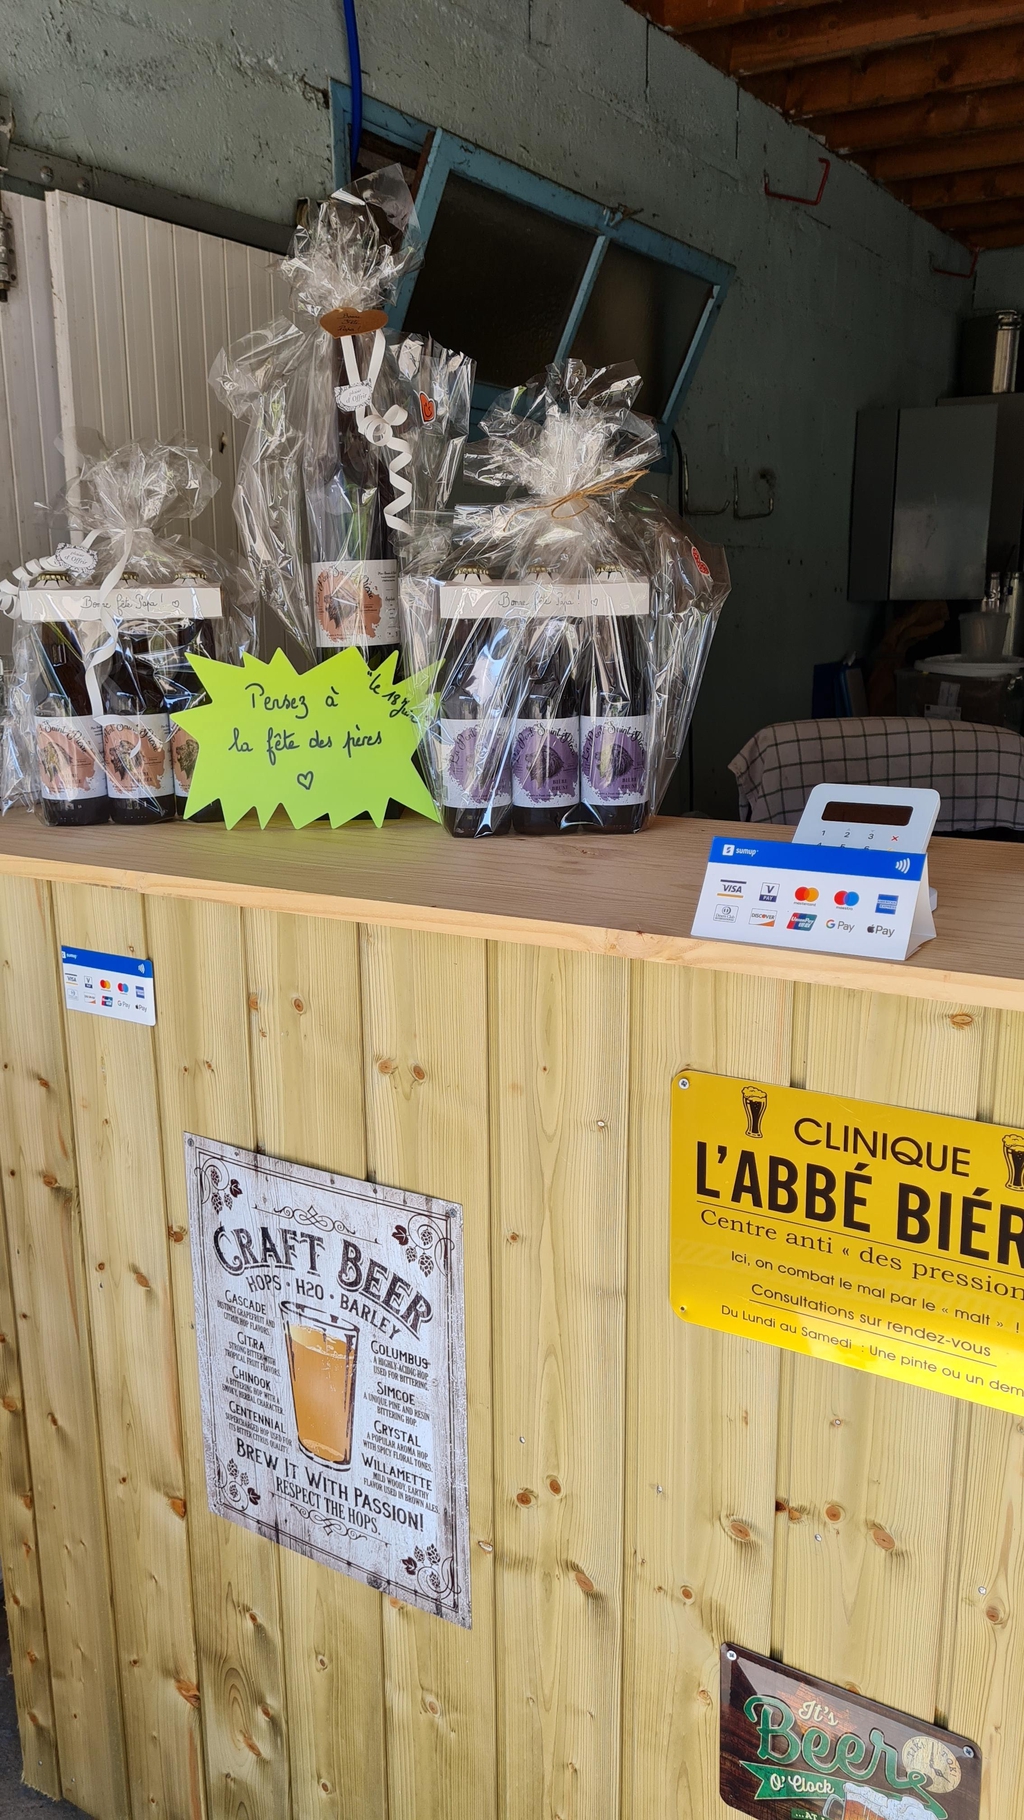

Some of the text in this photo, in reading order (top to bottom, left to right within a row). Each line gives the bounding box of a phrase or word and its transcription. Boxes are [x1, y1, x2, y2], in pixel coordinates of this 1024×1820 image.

[325, 686, 340, 707] à
[381, 691, 401, 705] 18
[228, 724, 382, 766] la fête des pères
[722, 884, 742, 893] VISA
[837, 920, 855, 933] Pay
[875, 925, 895, 938] Pay
[793, 1117, 971, 1178] CLINIQUE
[696, 1140, 873, 1233] L'ABBÉ
[700, 1208, 778, 1240] Centre
[785, 1231, 833, 1255] anti
[859, 1247, 903, 1272] des
[213, 1225, 434, 1337] CRAFT BEER
[731, 1250, 751, 1267] Ici,
[755, 1258, 773, 1271] on
[777, 1264, 835, 1286] combat
[839, 1277, 853, 1290] le
[857, 1283, 885, 1299] mal
[890, 1292, 917, 1307] par
[922, 1298, 936, 1312] le
[954, 1308, 991, 1326] malt
[225, 1289, 267, 1316] CASCADE
[246, 1274, 282, 1293] HOPS
[340, 1293, 400, 1341] BARLEY
[224, 1311, 240, 1325] CITRUS
[751, 1283, 991, 1357] Consultations sur rendez-vous
[228, 1341, 247, 1355] STRONG
[237, 1331, 265, 1353] CITRA
[370, 1340, 429, 1369] COLUMBUS
[721, 1304, 738, 1318] Du
[742, 1310, 776, 1328] Lundi
[779, 1321, 797, 1334] au
[801, 1326, 852, 1349] Samedi
[869, 1345, 896, 1361] Une
[900, 1354, 937, 1373] pinte
[942, 1367, 961, 1379] ou
[965, 1373, 984, 1386] un
[224, 1347, 246, 1364] TROPICAL
[246, 1356, 260, 1369] FRUIT
[373, 1355, 378, 1365] A
[416, 1370, 429, 1381] HOP
[232, 1365, 271, 1391] CHINOOK
[373, 1365, 387, 1377] USED
[387, 1370, 399, 1381] FOR
[229, 1377, 253, 1393] BITTERING
[253, 1387, 263, 1397] HOP
[263, 1391, 276, 1403] WITH
[238, 1390, 256, 1404] HERBAL
[376, 1381, 415, 1406] SIMCOE
[229, 1400, 286, 1434] CENTENNIAL
[363, 1392, 430, 1421] A UNIQUE PINE AND RESIN
[377, 1406, 405, 1423] BITTERING
[225, 1412, 293, 1447] SUPERCHARGED HOP USED FOR
[228, 1422, 236, 1432] ITS
[236, 1425, 253, 1439] BITTER
[253, 1433, 269, 1446] CITRUS
[374, 1419, 421, 1448] CRYSTAL
[362, 1439, 377, 1452] WITH
[377, 1445, 393, 1458] SPICY
[392, 1450, 413, 1465] FLORAL
[366, 1431, 429, 1461] A POPULAR AROMA HOP
[236, 1437, 279, 1471] BREW
[304, 1465, 349, 1502] WITH
[354, 1486, 424, 1533] PASSION!
[361, 1452, 433, 1491] WILLAMETTE
[373, 1471, 386, 1483] MILD
[407, 1485, 429, 1501] EARTHY
[276, 1475, 381, 1536] RESPECT THE HOPS.
[363, 1477, 383, 1492] FLAVOR
[383, 1485, 398, 1498] USED
[397, 1491, 404, 1500] IN
[404, 1493, 425, 1508] BROWN
[798, 1700, 839, 1727] It's
[743, 1694, 948, 1820] Beer
